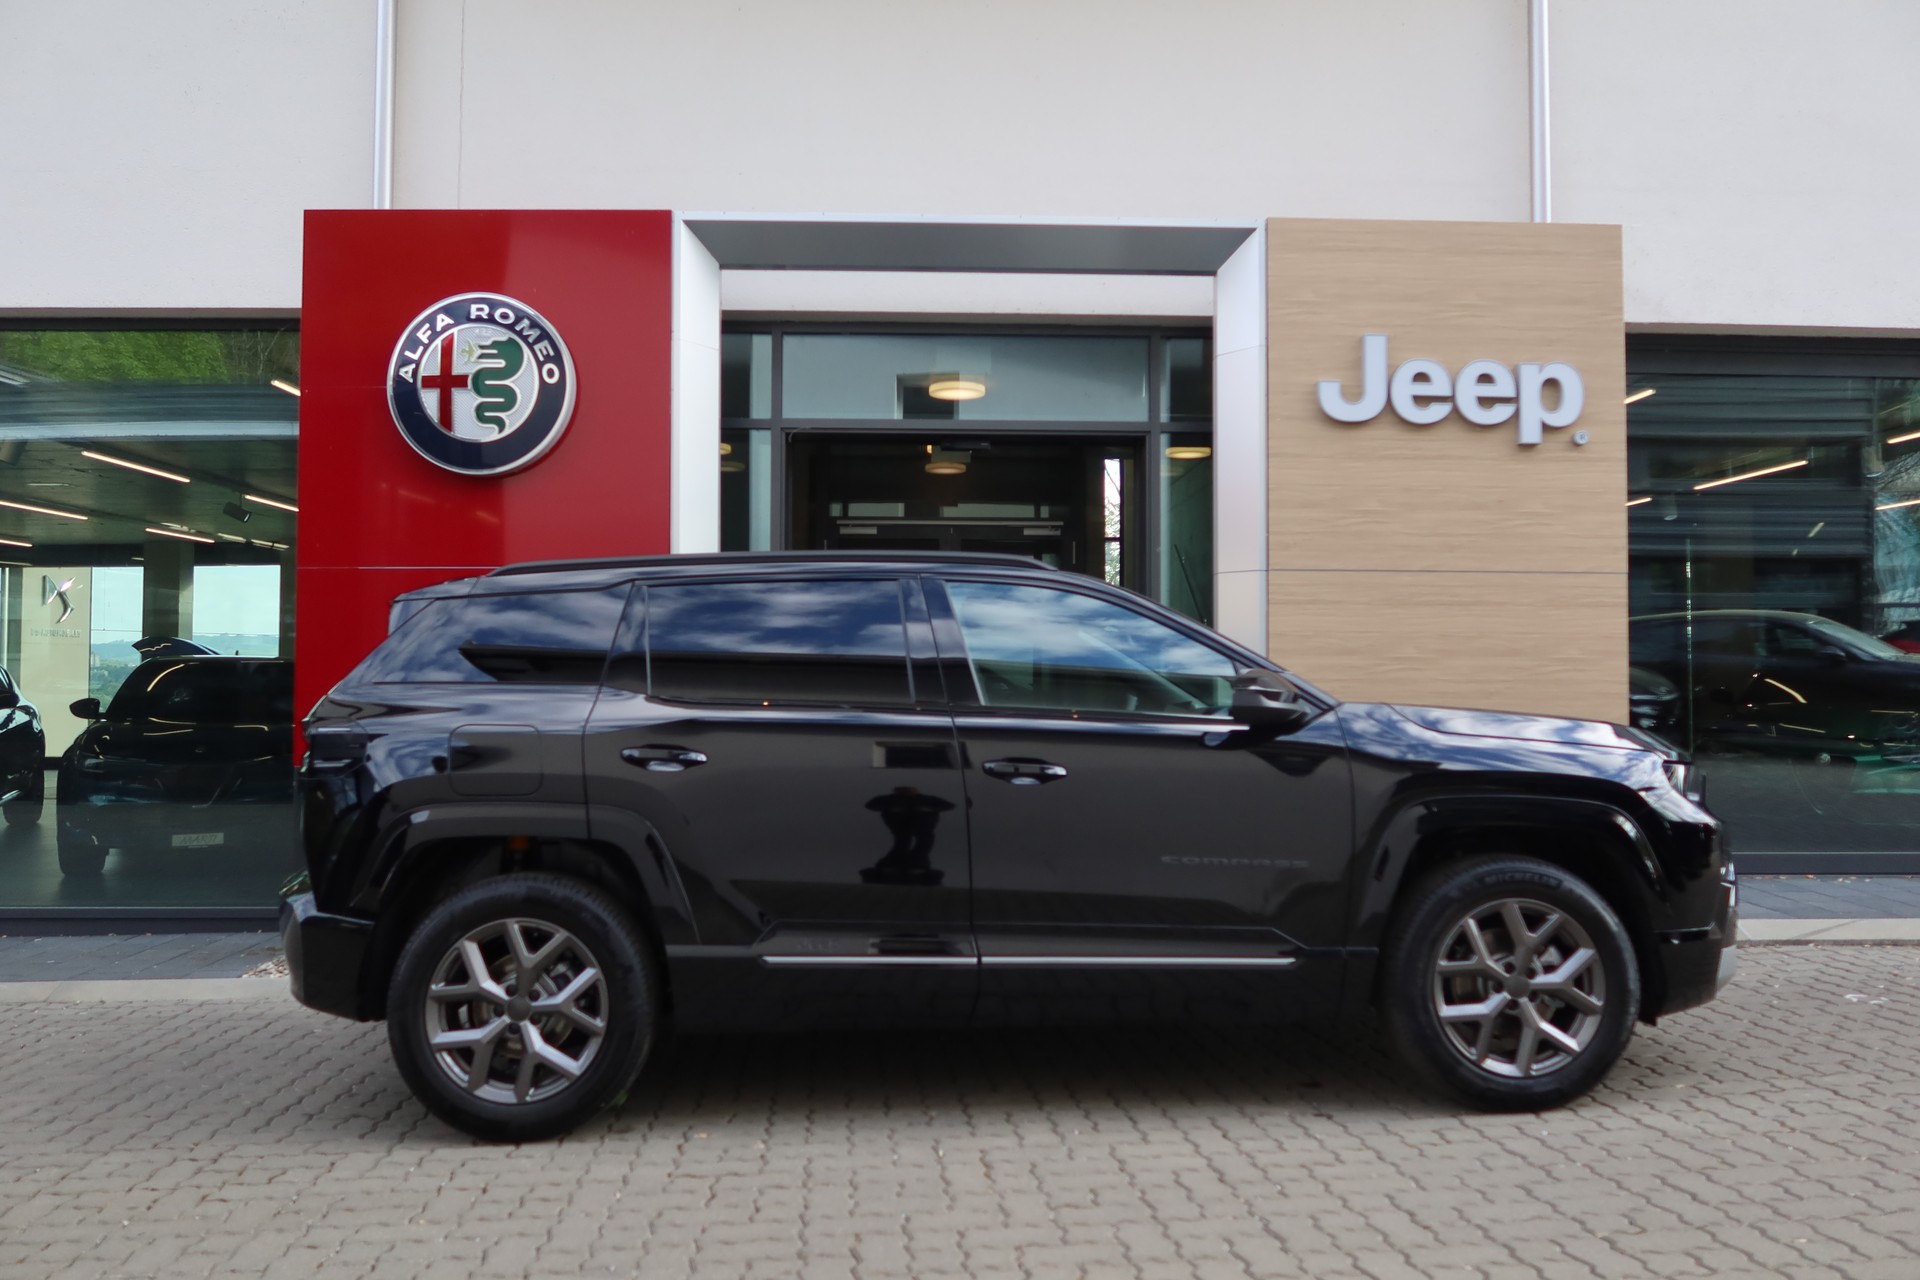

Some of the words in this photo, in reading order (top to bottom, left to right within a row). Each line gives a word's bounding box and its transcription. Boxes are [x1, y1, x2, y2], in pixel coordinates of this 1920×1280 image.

[399, 313, 455, 383] ALFA
[470, 304, 560, 384] ROMEO
[1317, 333, 1585, 445] Jeep
